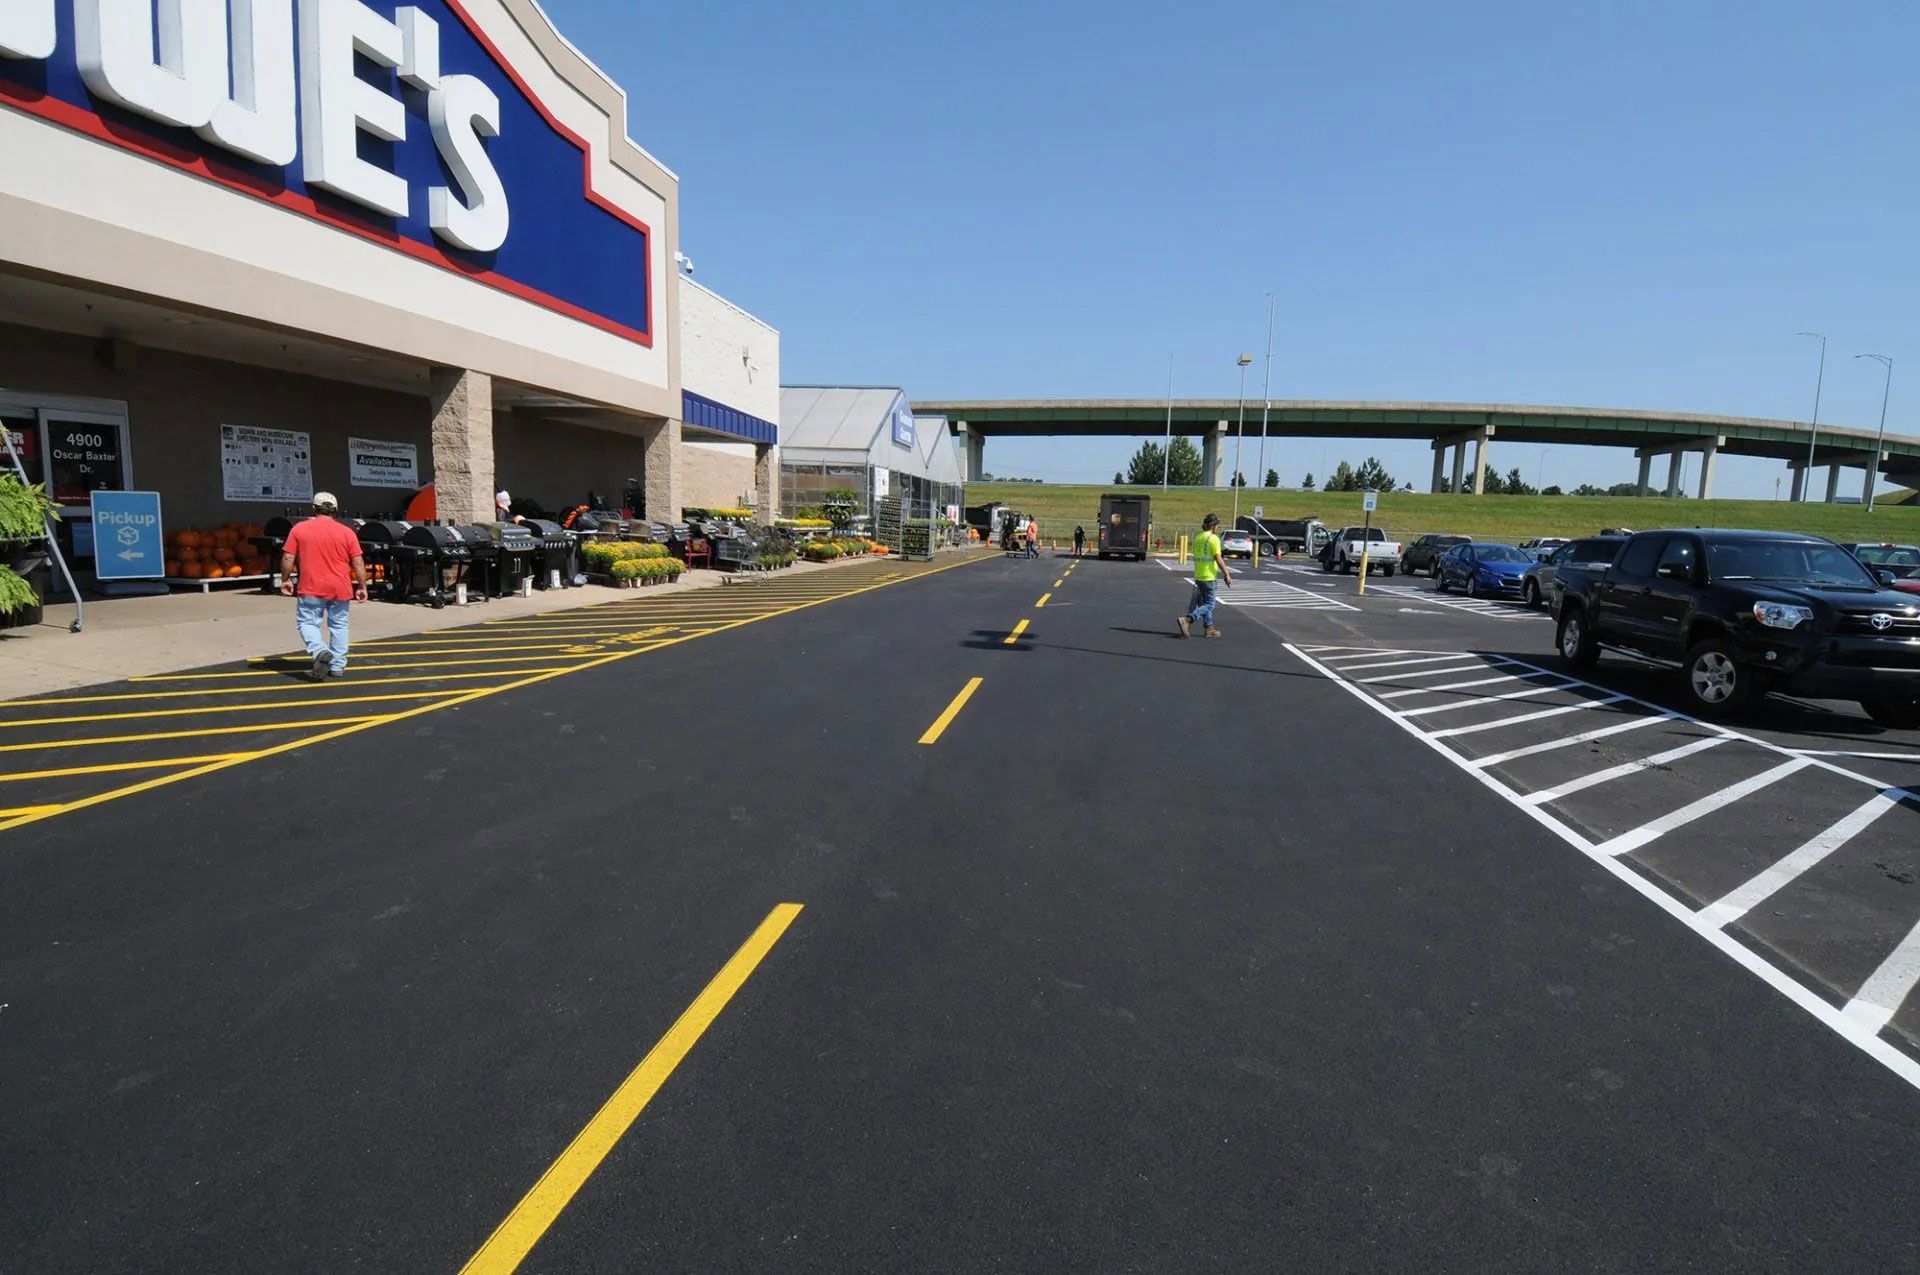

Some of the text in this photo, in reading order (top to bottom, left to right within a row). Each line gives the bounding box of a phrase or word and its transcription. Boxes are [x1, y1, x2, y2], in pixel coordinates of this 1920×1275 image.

[66, 433, 102, 447] 4900
[53, 449, 117, 461] Oscar Baxter
[359, 455, 393, 466] Available
[79, 464, 94, 474] Dr.
[98, 511, 156, 527] Pickup
